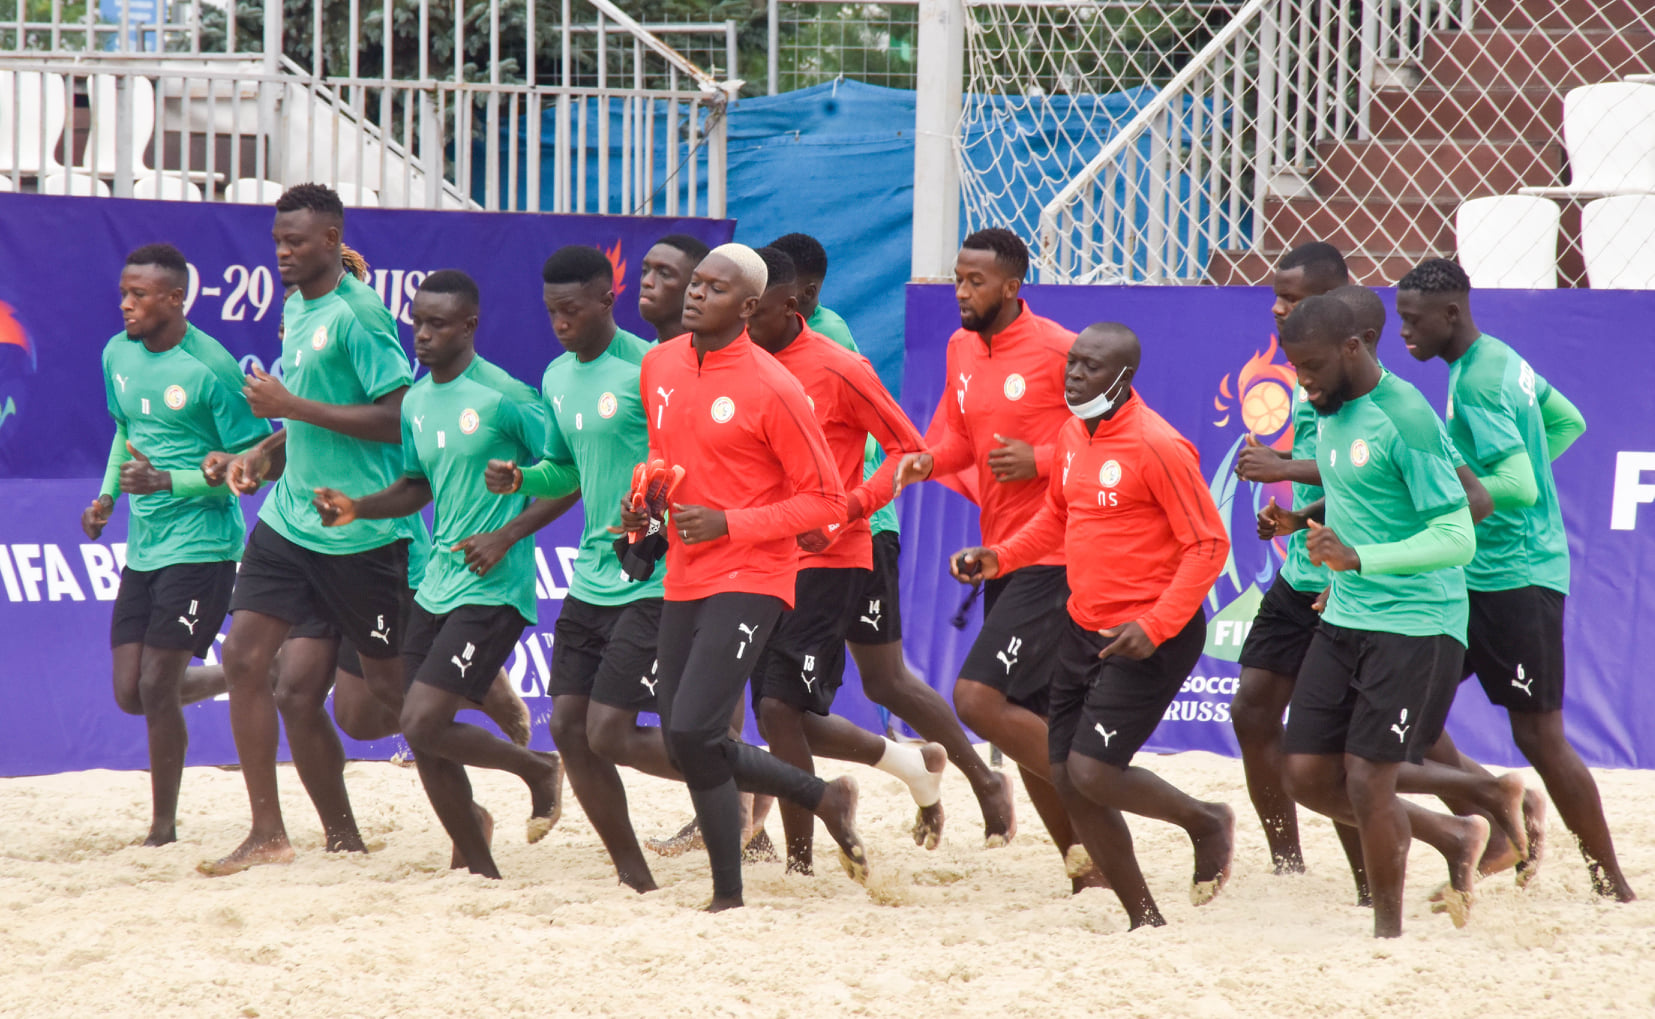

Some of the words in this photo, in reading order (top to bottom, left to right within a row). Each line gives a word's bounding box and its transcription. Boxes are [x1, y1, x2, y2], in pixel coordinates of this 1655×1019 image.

[183, 263, 274, 322] 9-29
[141, 398, 150, 415] 11
[1330, 449, 1337, 467] 9
[189, 600, 198, 616] 11
[869, 600, 881, 614] 14
[462, 642, 475, 661] 10
[1007, 636, 1022, 656] 12
[803, 655, 815, 671] 13
[1517, 663, 1525, 680] 6
[1162, 700, 1233, 723] RUSS
[1400, 708, 1408, 725] 9
